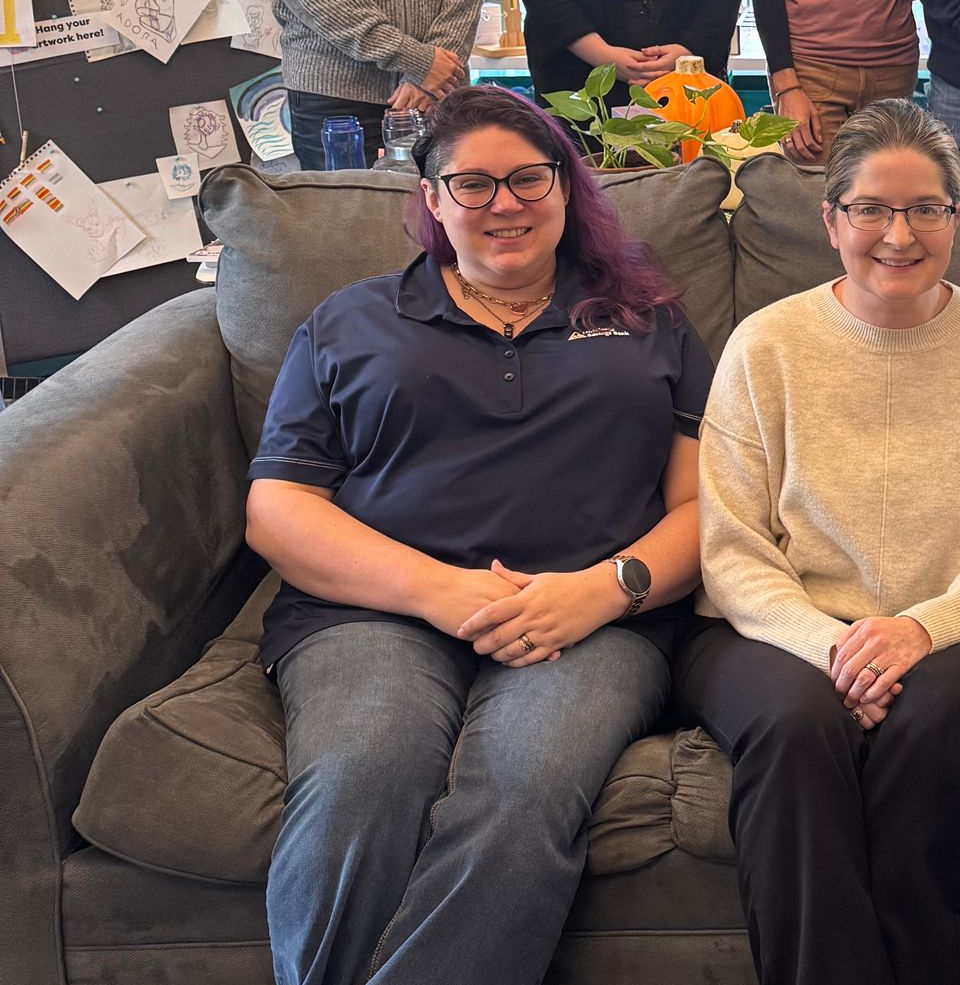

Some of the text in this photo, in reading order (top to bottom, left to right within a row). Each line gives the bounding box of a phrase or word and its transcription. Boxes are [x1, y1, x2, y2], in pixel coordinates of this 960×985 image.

[36, 18, 91, 35] Hang your
[116, 12, 158, 50] ADORA
[35, 28, 104, 48] rtwork here!
